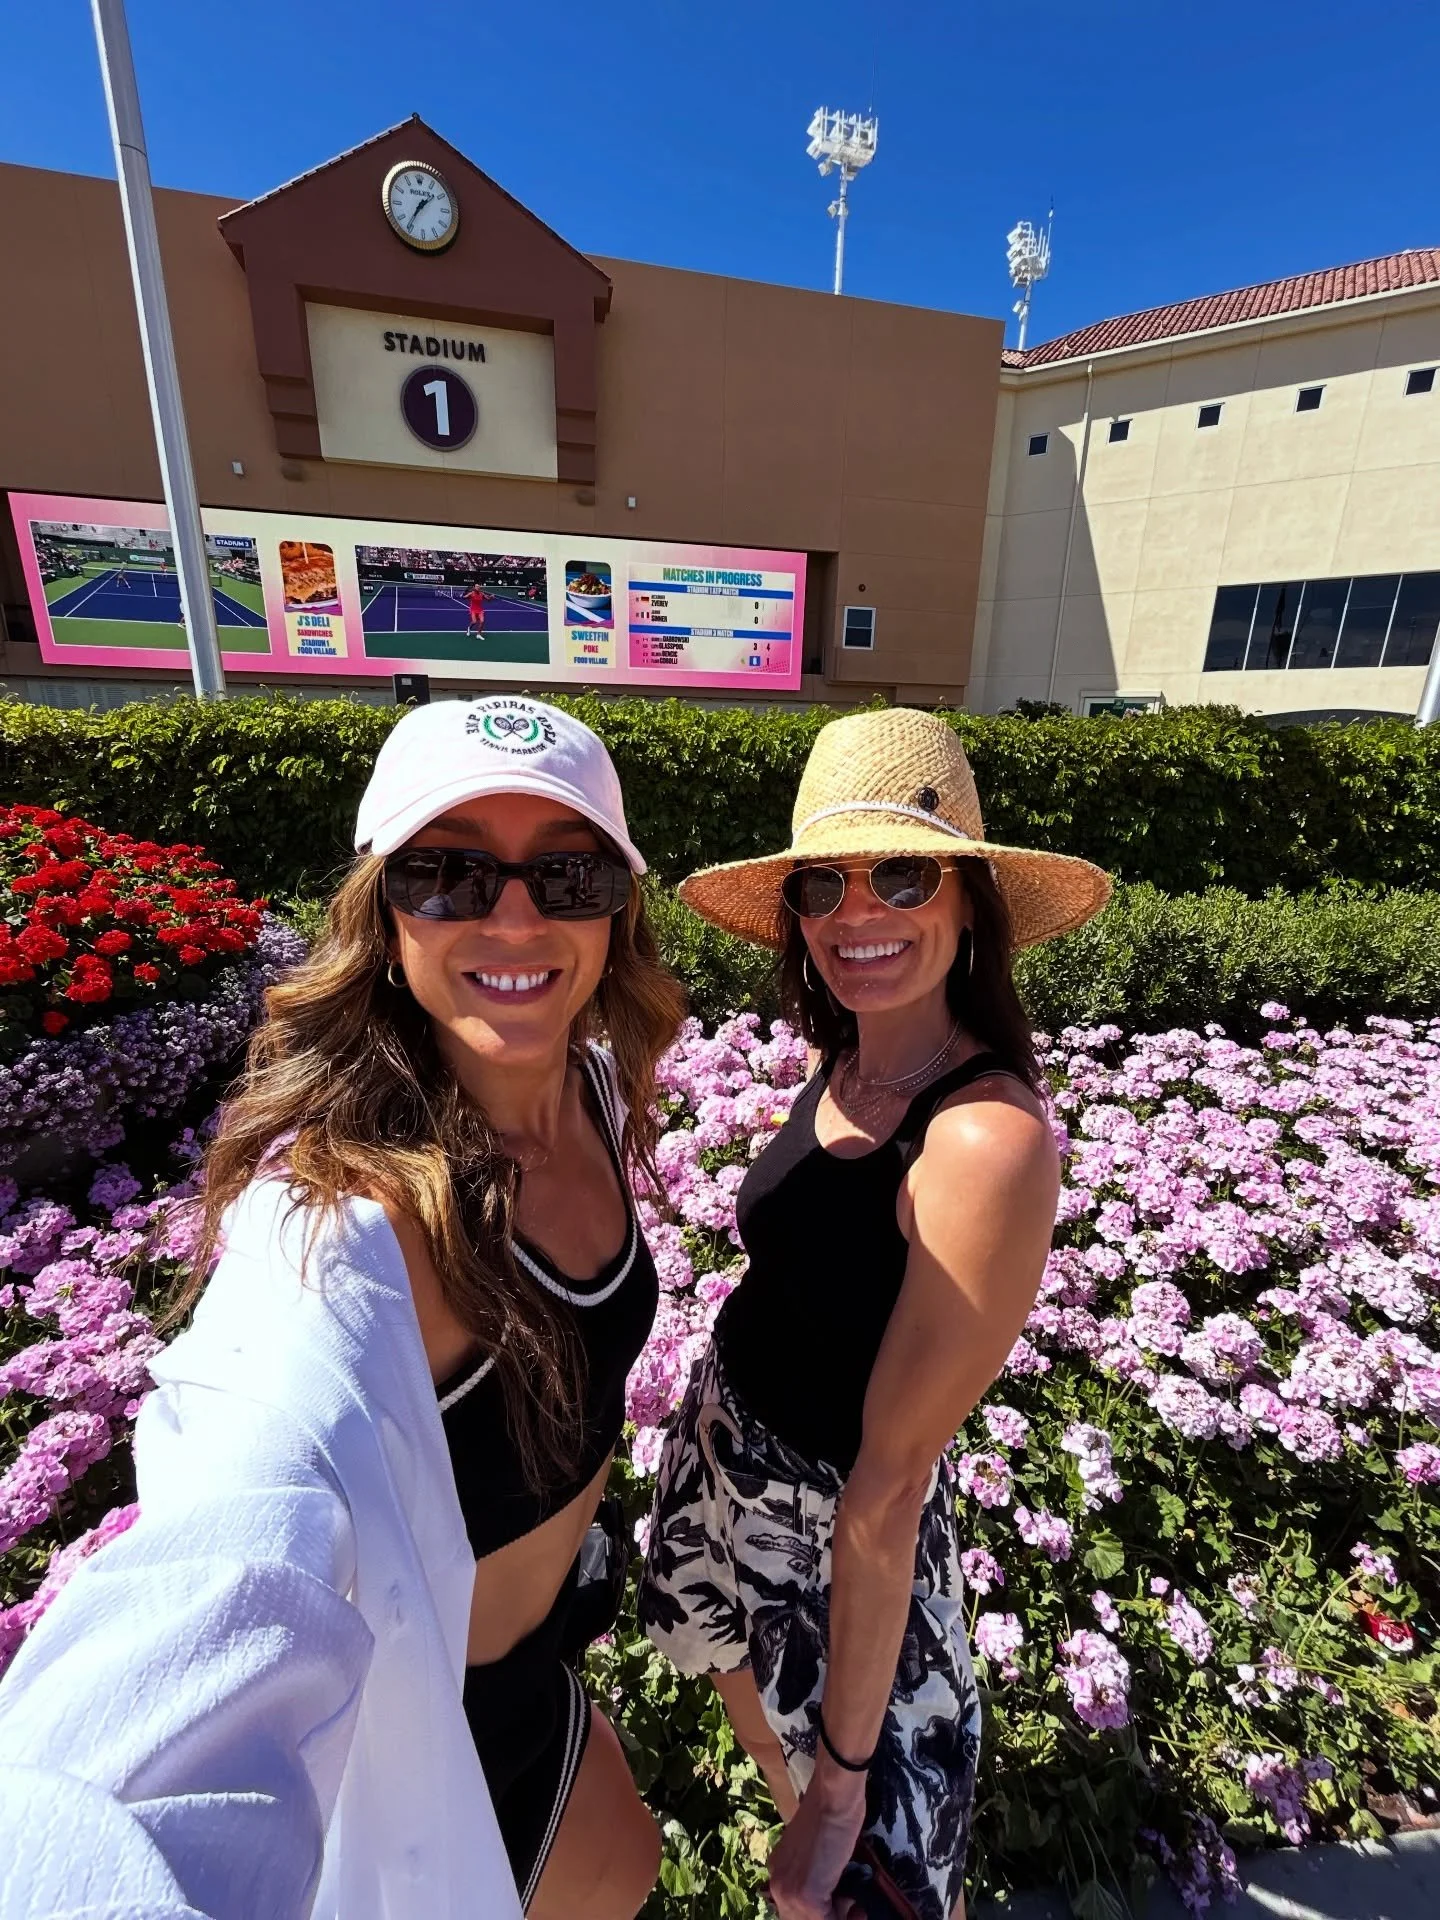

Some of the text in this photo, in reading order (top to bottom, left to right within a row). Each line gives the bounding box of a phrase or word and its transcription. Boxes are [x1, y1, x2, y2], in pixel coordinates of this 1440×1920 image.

[410, 188, 431, 197] ROLEX
[384, 331, 486, 363] STADIUM
[423, 379, 450, 436] 1
[216, 539, 245, 547] STADIUM
[663, 567, 762, 586] MATCHES IN PROGRESS
[687, 586, 709, 594] STADIUM
[754, 602, 759, 610] 0
[297, 616, 330, 628] J'S DELI
[754, 616, 759, 624] 0
[297, 629, 334, 638] SANDWICHES
[571, 630, 609, 642] SWEETFIN
[691, 628, 712, 637] STADIUM
[301, 638, 326, 647] STADIUM
[754, 642, 758, 650] 3
[766, 643, 770, 651] 4
[298, 646, 337, 656] FOOD VILLAGE
[583, 644, 598, 653] POKE
[480, 738, 508, 753] TENNIS
